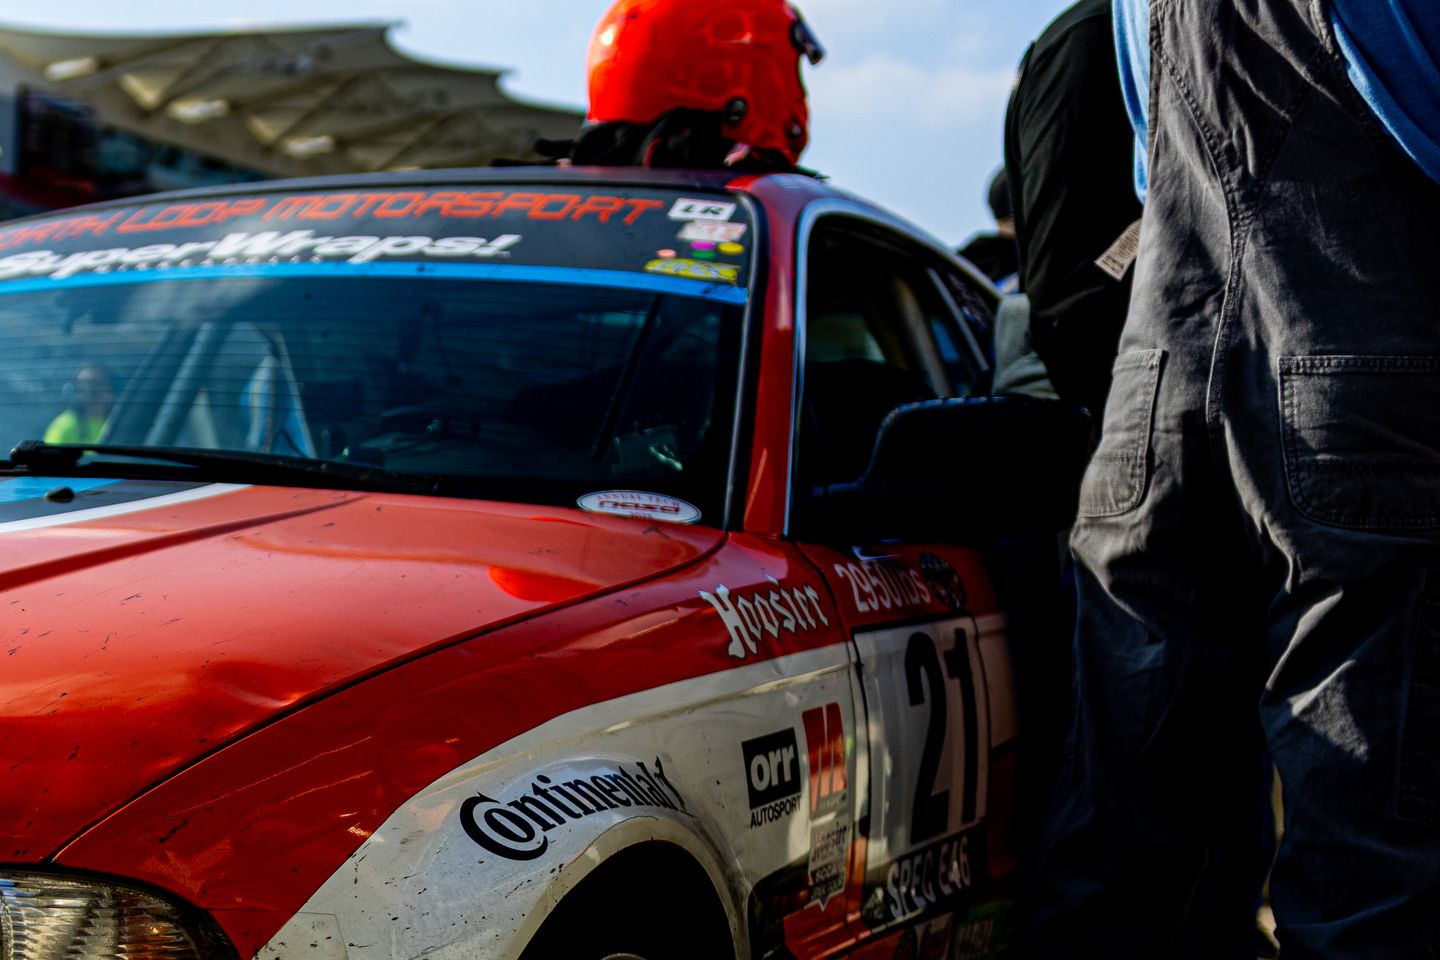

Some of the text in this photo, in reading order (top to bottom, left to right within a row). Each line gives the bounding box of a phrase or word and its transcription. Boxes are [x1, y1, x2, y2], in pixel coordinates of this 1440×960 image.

[116, 198, 267, 233] LOOP
[262, 192, 664, 225] MOTORSPORT
[750, 743, 795, 792] orr
[904, 627, 977, 847] 21
[459, 756, 690, 861] Continental
[750, 794, 802, 830] AUTOSPORT
[886, 848, 937, 919] SPEC
[938, 834, 973, 896] E46
